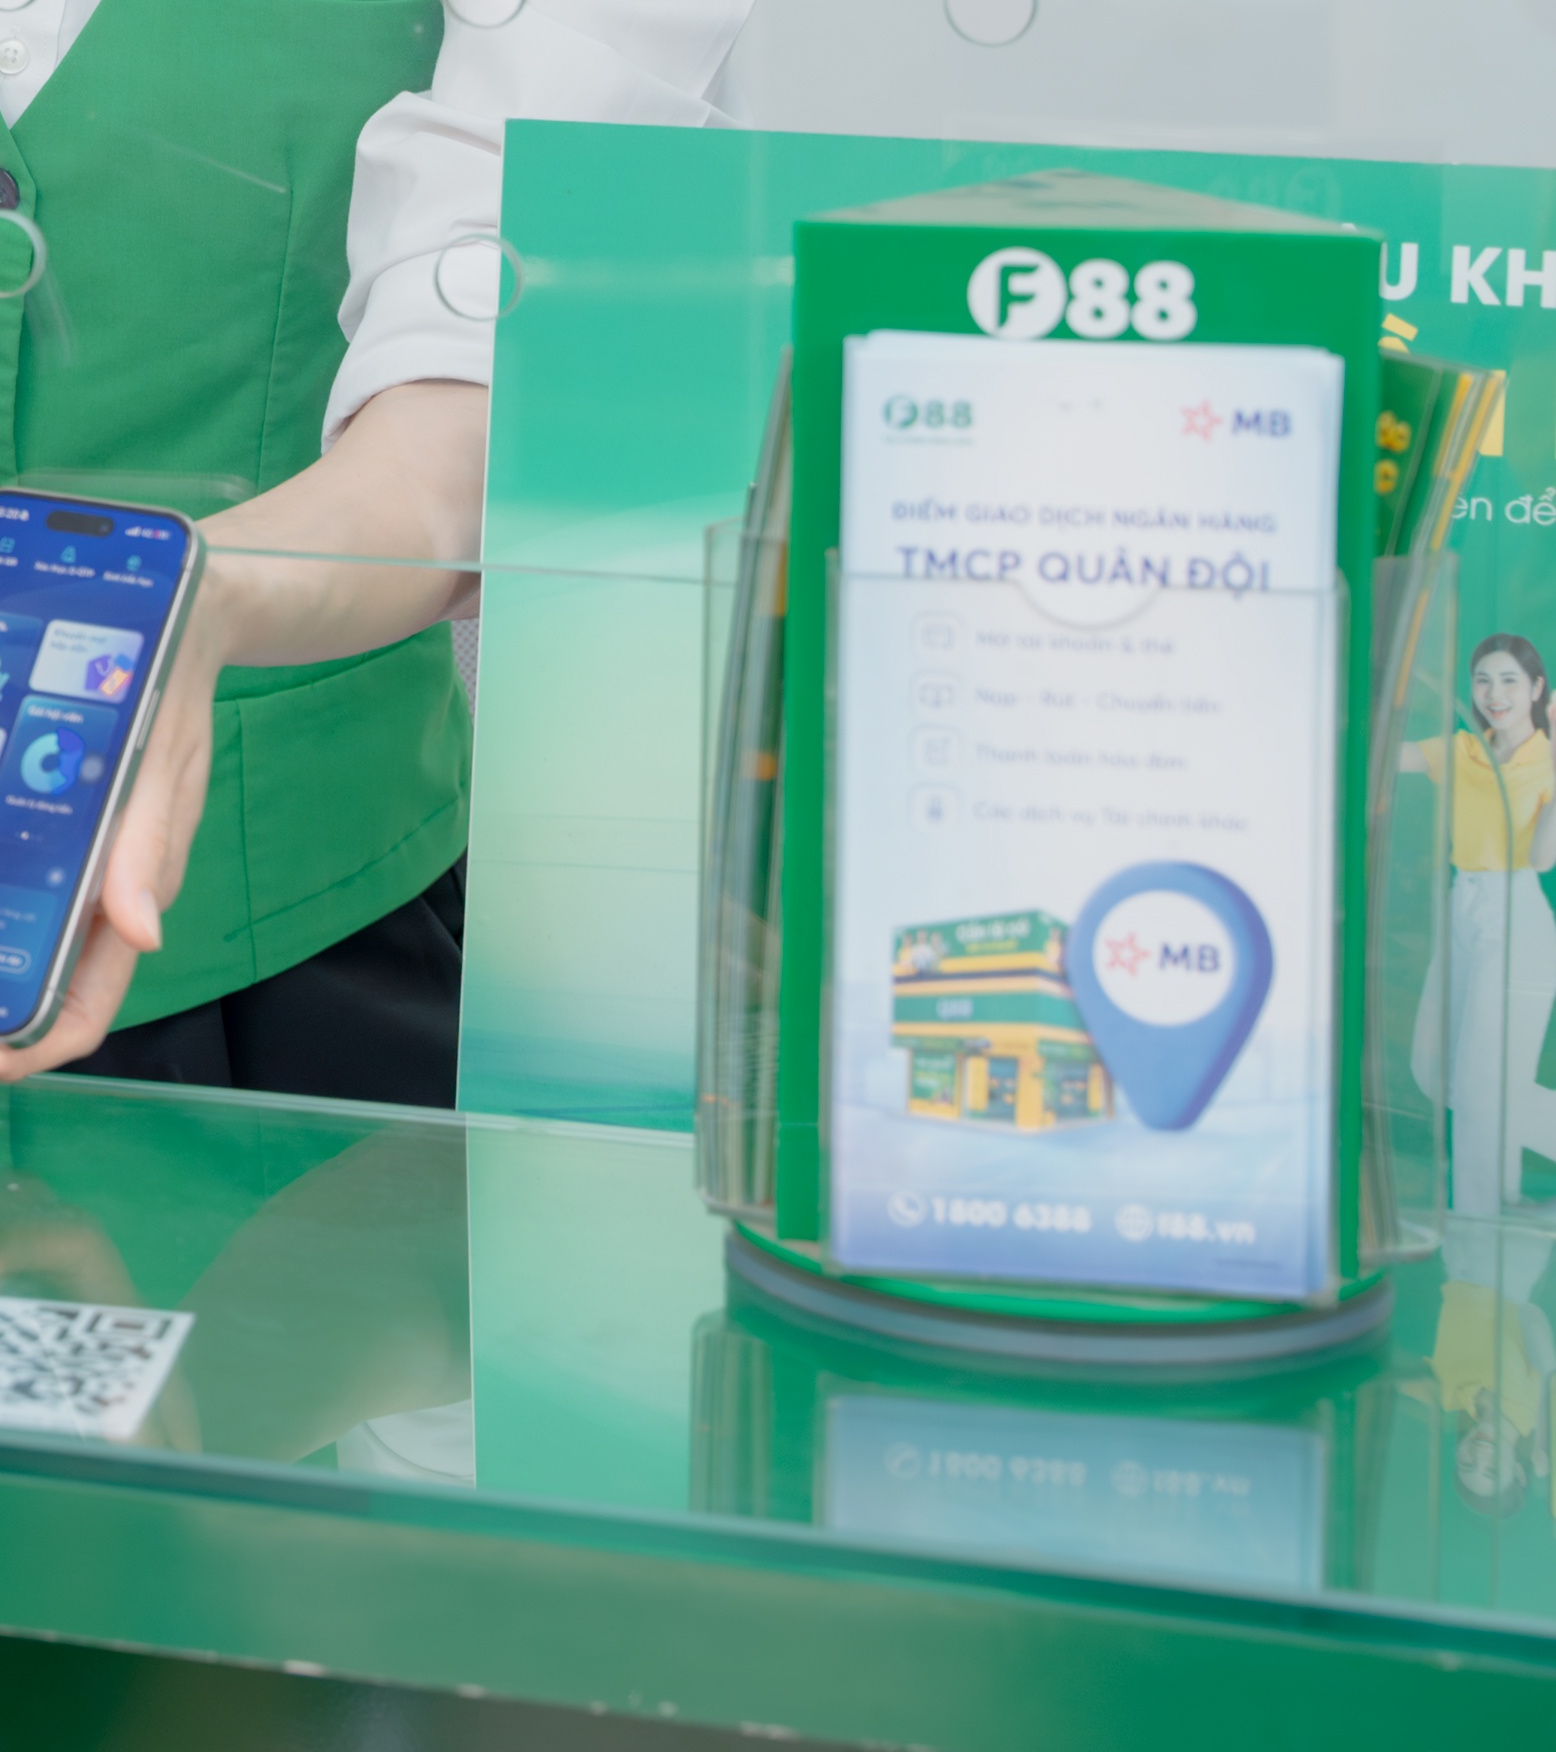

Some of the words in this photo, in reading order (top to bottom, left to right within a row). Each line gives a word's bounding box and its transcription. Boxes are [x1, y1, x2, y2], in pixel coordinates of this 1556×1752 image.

[966, 246, 1197, 341] F88
[1231, 408, 1291, 439] MB
[896, 545, 1022, 584] TMCP
[1036, 545, 1171, 590] QUÂN
[1186, 548, 1271, 600] ĐỘI
[1158, 943, 1220, 973] MB
